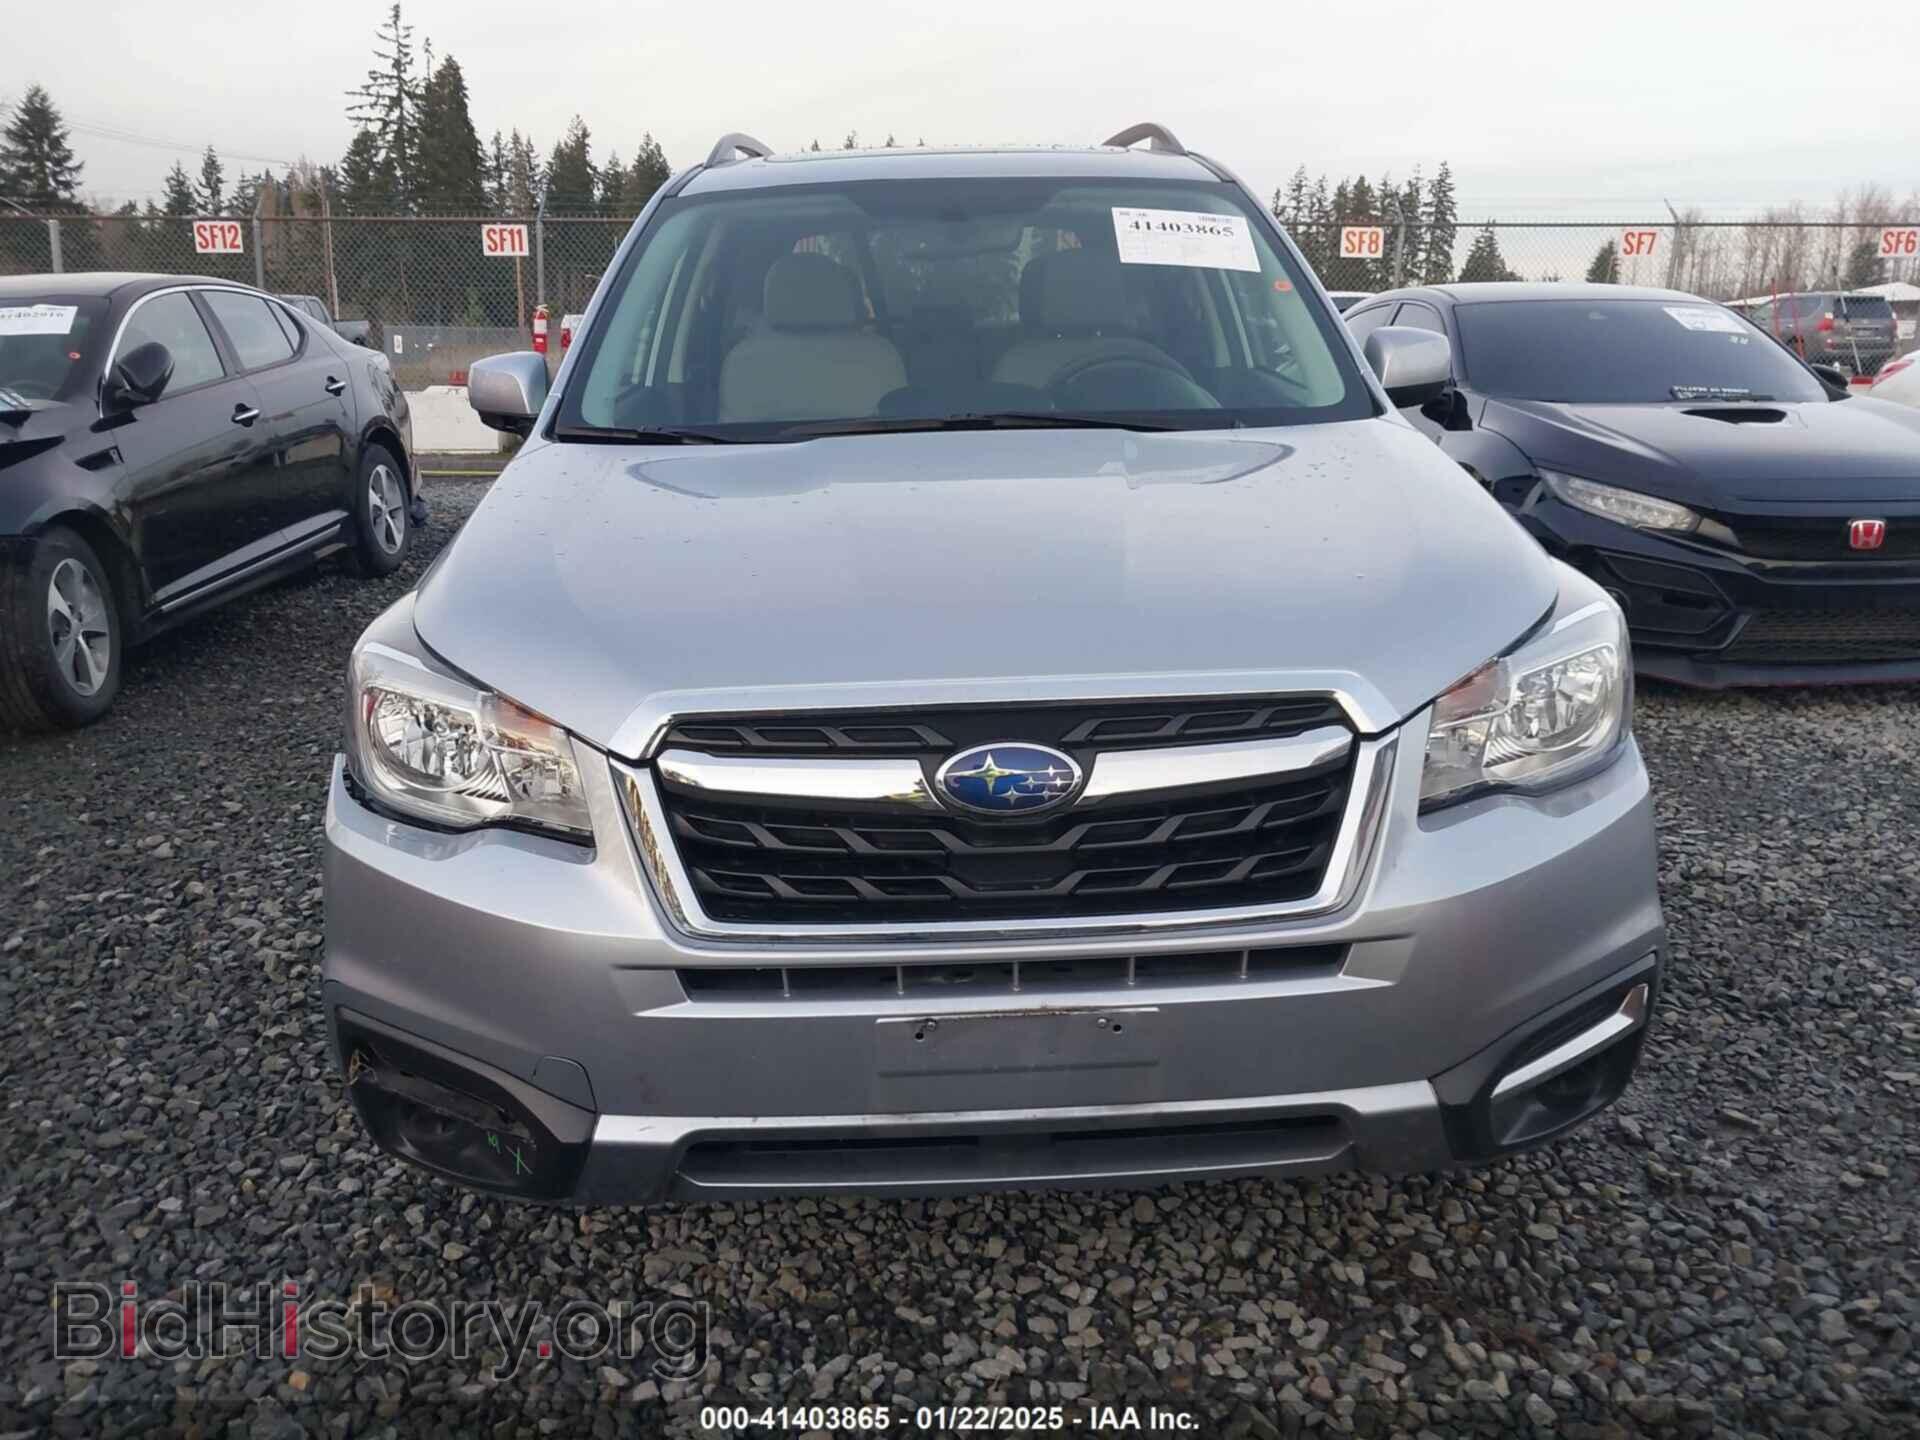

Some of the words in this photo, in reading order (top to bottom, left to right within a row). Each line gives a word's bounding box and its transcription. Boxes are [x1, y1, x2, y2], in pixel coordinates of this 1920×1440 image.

[196, 224, 241, 249] SF12
[486, 227, 524, 252] SF11
[1129, 219, 1234, 237] 41403865
[1345, 230, 1380, 254] SF8
[1623, 231, 1657, 255] SF7
[1882, 231, 1917, 254] SF6
